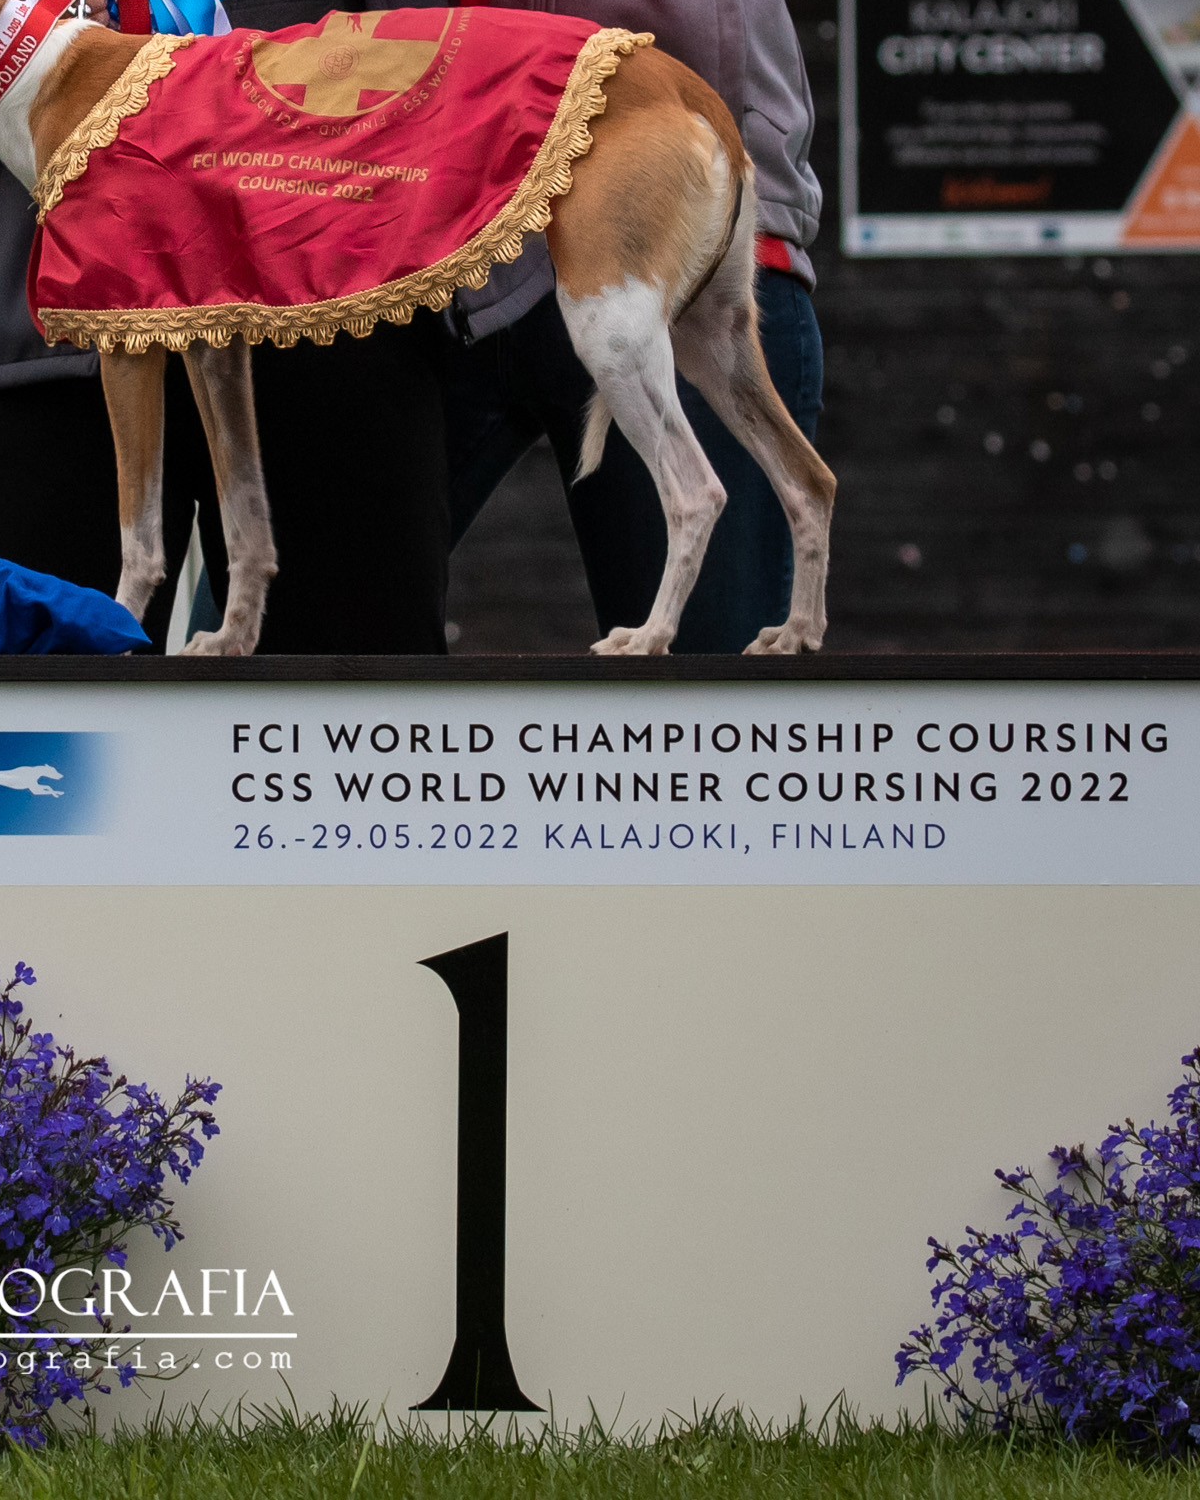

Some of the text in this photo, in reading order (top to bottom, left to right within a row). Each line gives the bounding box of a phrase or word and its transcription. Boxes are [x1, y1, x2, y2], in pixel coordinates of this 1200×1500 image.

[403, 89, 429, 112] CSS
[428, 37, 462, 88] WORLD
[277, 112, 300, 130] FCI
[319, 113, 388, 136] FINLAND
[192, 151, 429, 182] FCI WORLD CHAMPIONSHIPS
[238, 175, 375, 202] COURSING 2022
[233, 722, 1168, 754] FCI WORLD CHAMPIONSHIP COURSING
[231, 771, 1129, 803] CSS WORLD WINNER COURSING 2022
[233, 823, 947, 855] 26.-29.05.2022 KALAJOKI, FINLAND
[408, 931, 548, 1412] 1
